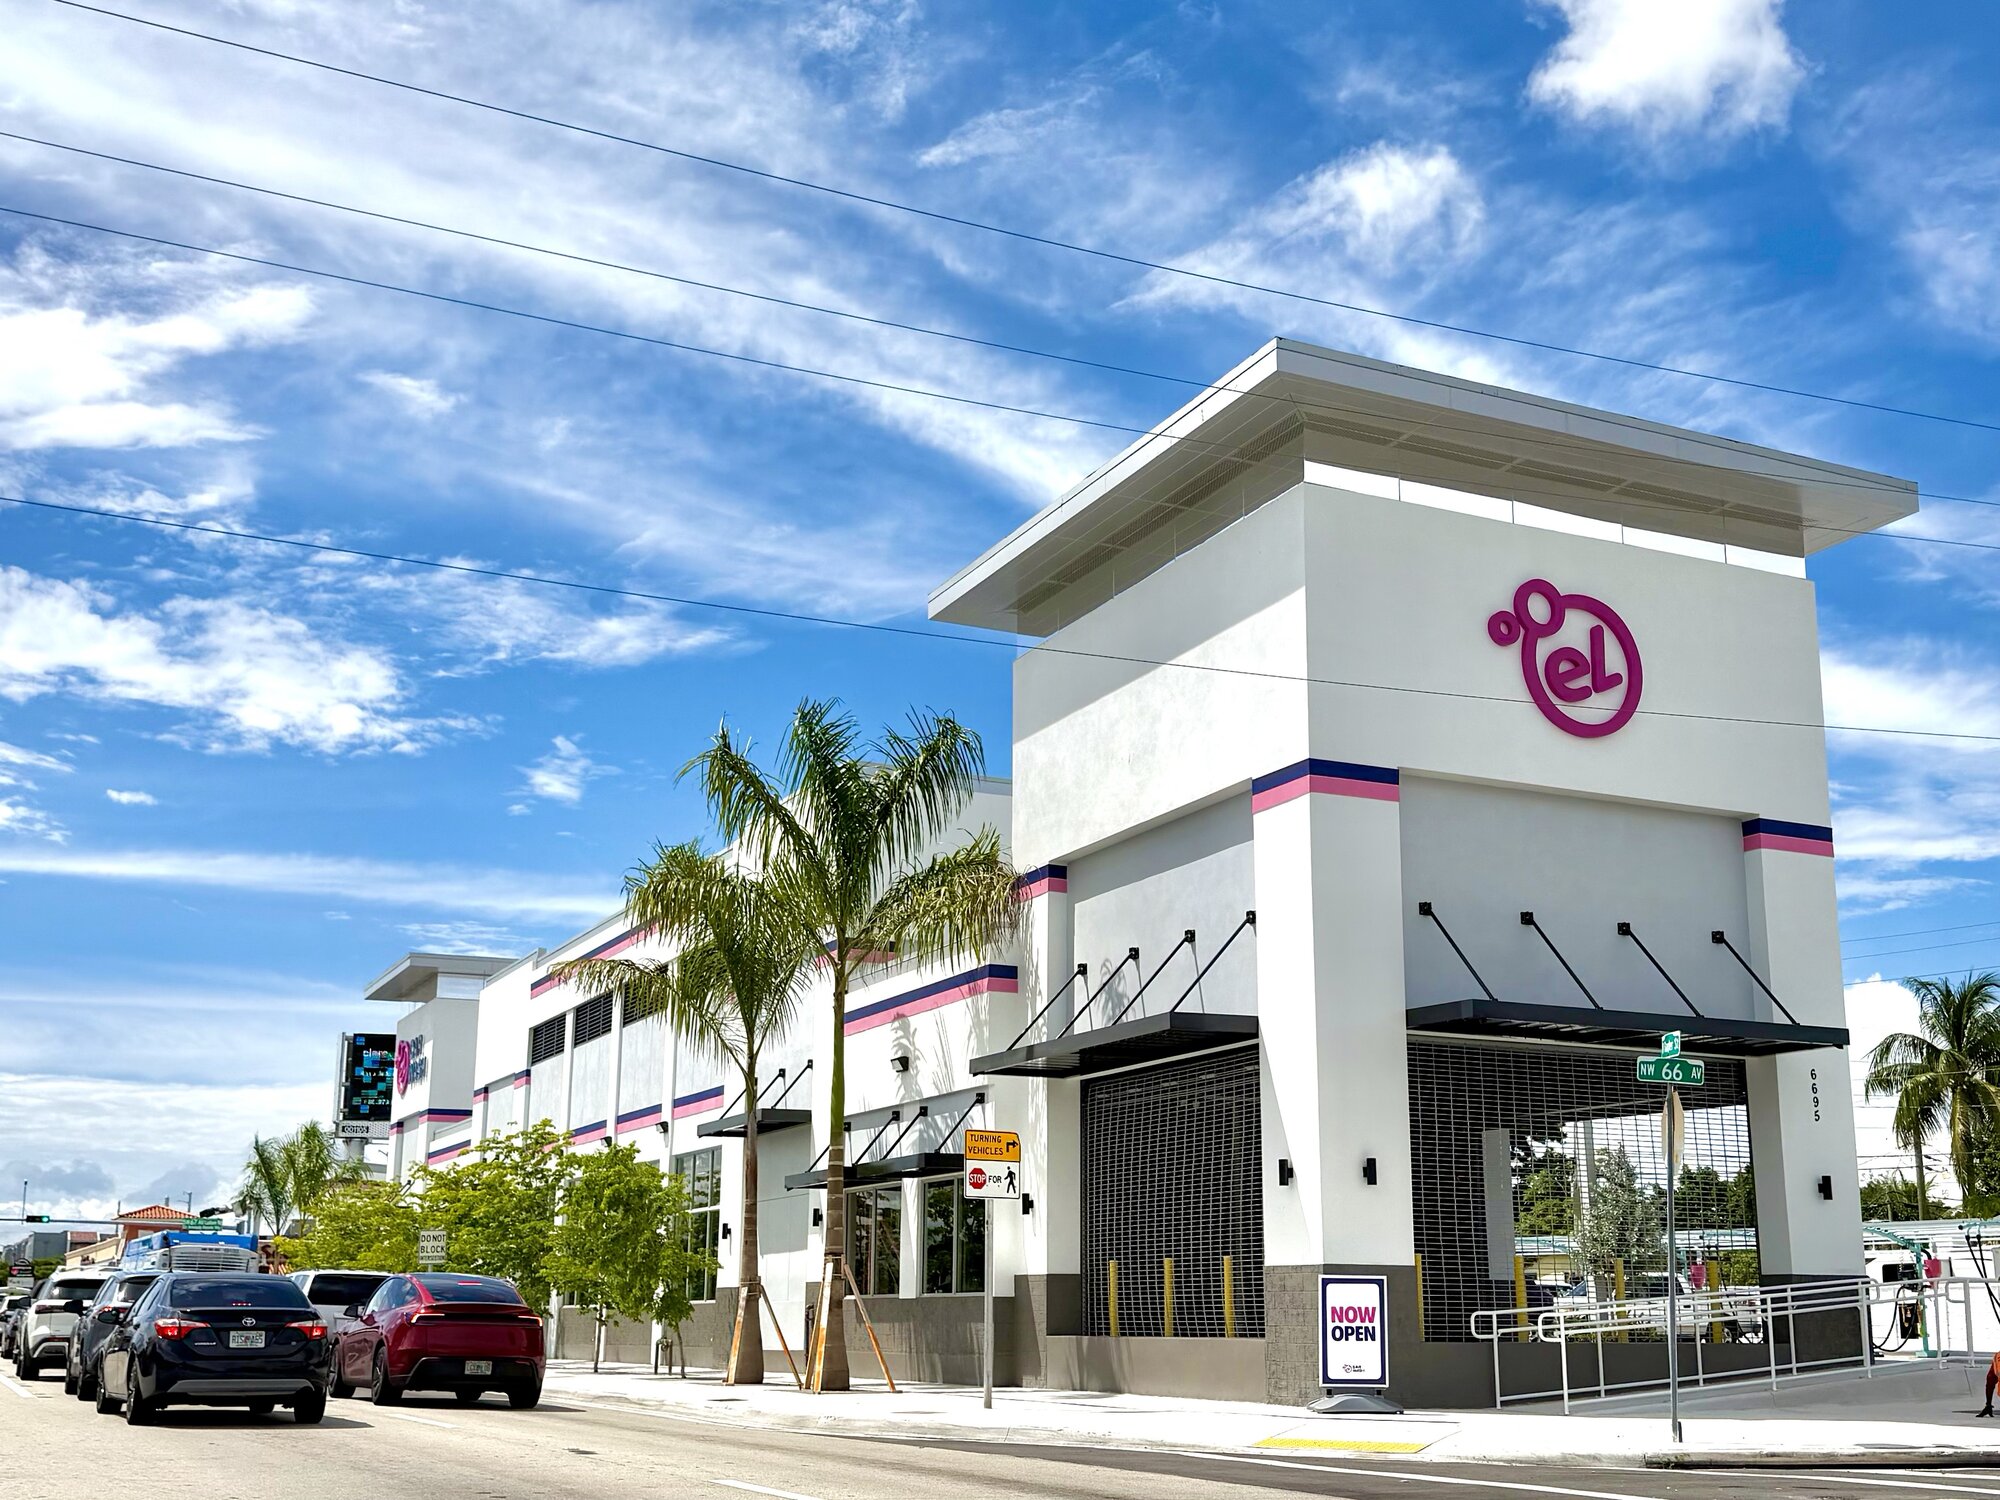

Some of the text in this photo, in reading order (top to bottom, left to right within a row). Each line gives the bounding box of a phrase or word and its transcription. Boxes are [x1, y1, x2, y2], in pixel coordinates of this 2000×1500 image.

[1640, 1062, 1702, 1081] NW 66 AV
[1810, 1068, 1820, 1122] 6695
[970, 1134, 1002, 1144] TURNING
[968, 1146, 1004, 1156] VEHICLES
[969, 1174, 1002, 1184] STOP FOR
[421, 1234, 446, 1242] DO NOT
[420, 1245, 446, 1253] BLOCK
[1331, 1306, 1376, 1324] NOW
[1331, 1326, 1376, 1341] OPEN
